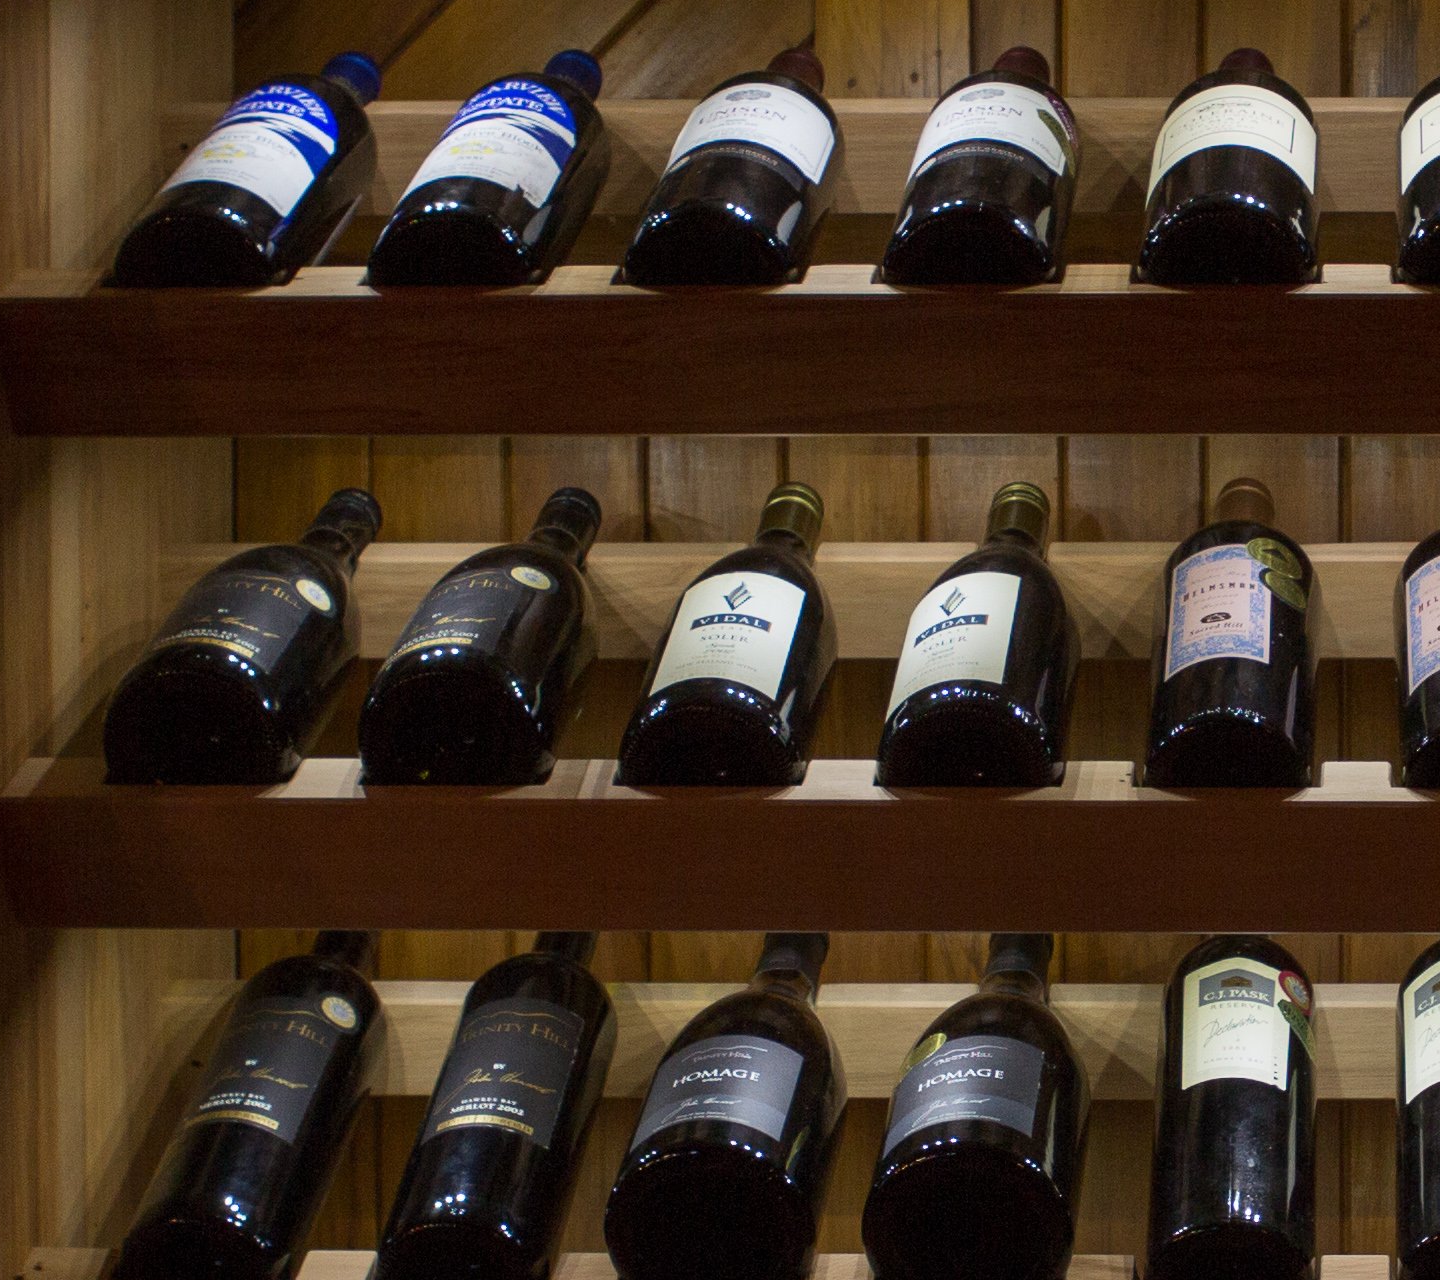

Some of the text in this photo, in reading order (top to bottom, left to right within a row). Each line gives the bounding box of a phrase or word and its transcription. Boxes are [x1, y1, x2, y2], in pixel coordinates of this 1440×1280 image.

[699, 614, 765, 629] VIDAL
[1231, 986, 1270, 1003] PASK
[672, 1068, 762, 1088] HOMAGE
[917, 1068, 1005, 1093] HOMAGE
